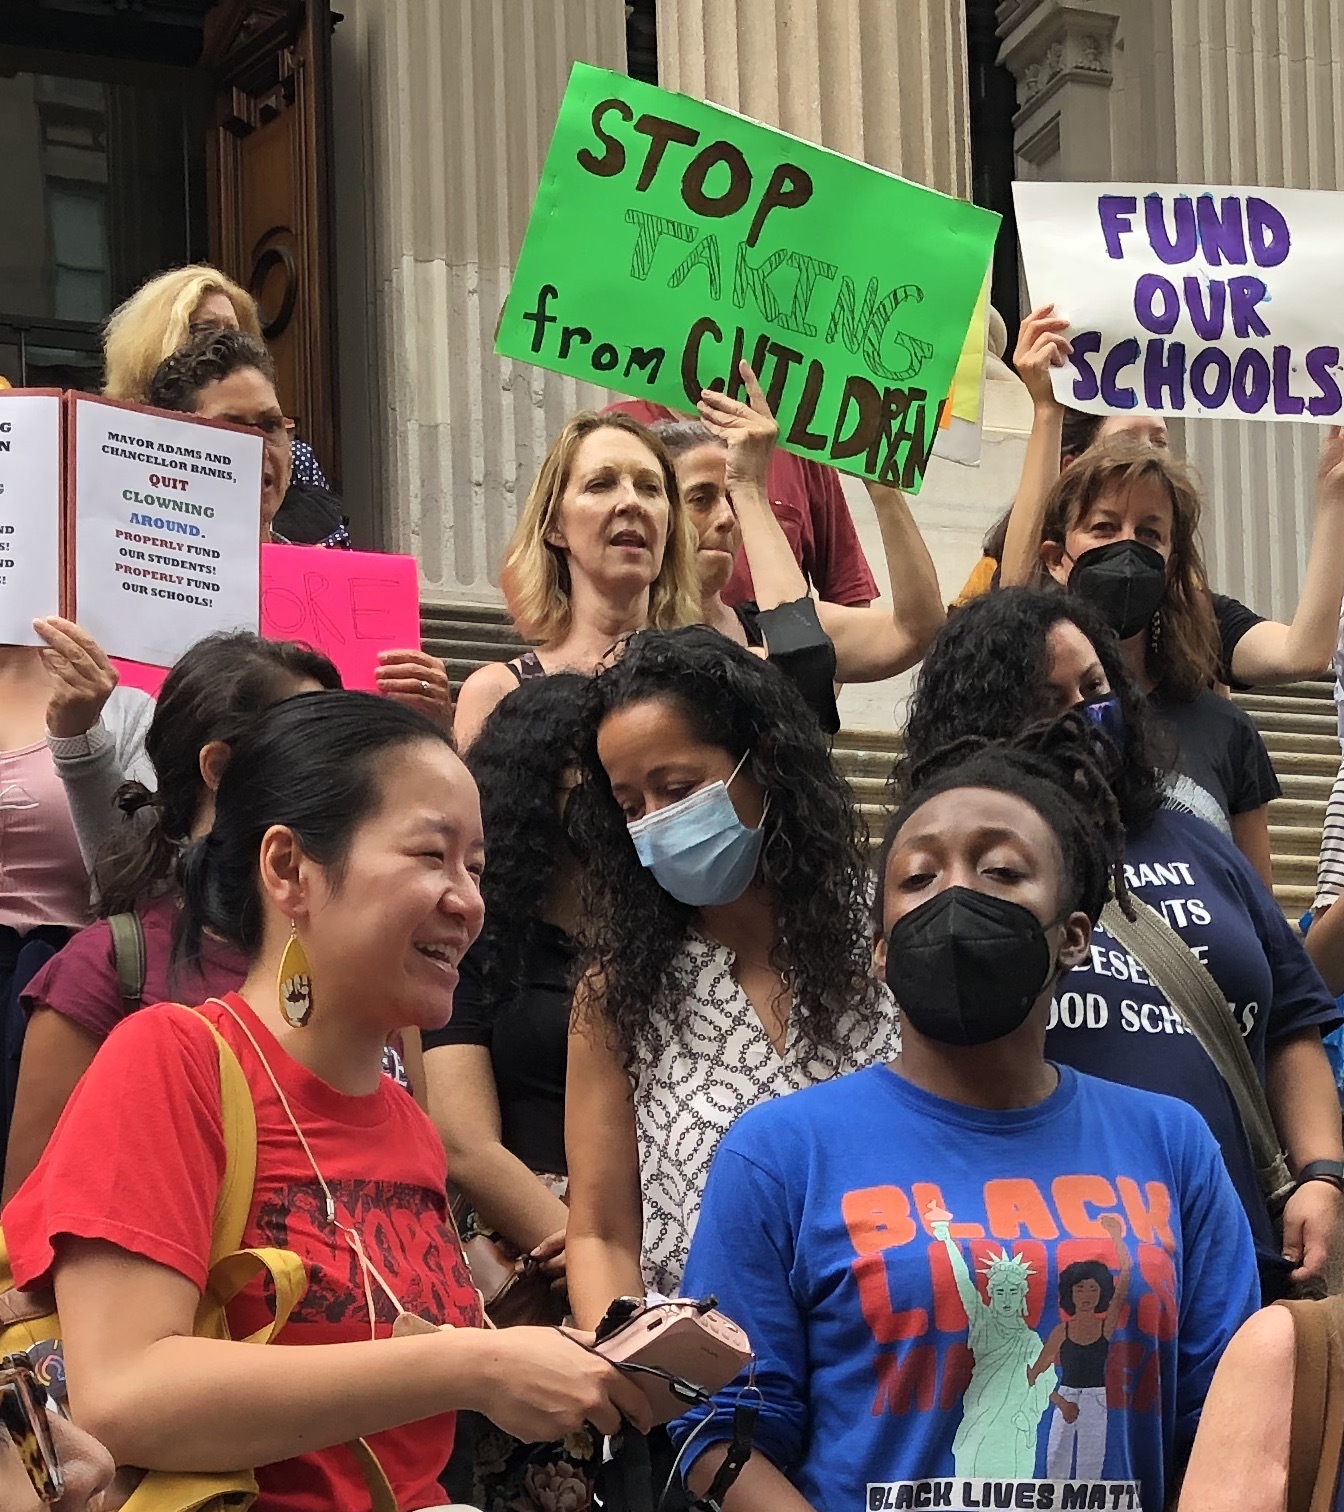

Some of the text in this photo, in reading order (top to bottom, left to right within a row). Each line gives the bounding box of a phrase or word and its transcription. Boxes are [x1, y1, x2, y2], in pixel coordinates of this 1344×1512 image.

[576, 98, 813, 248] STOP
[1098, 193, 1291, 268] FUND
[625, 209, 933, 382] TAKING
[1133, 272, 1272, 342] OUR
[523, 284, 948, 489] from CHILDREN
[1069, 330, 1342, 418] SCHOOLS
[101, 445, 237, 484] CHANCELLOR BANKS,
[107, 431, 232, 466] MAYOR ADAMS AND
[148, 473, 189, 492] QUIT
[122, 489, 215, 520] CLOWNING
[129, 512, 206, 539] AROUND.
[115, 529, 221, 560] PROPERLY FUND
[119, 547, 217, 576] OUR STUDENTS!
[115, 562, 221, 593] PROPERLY FUND
[122, 581, 214, 608] OUR SCHOOLS!
[1121, 1000, 1259, 1036] SCHS
[841, 1174, 1177, 1256] BLACK
[869, 1481, 1142, 1510] BLACK LIVES MATT
